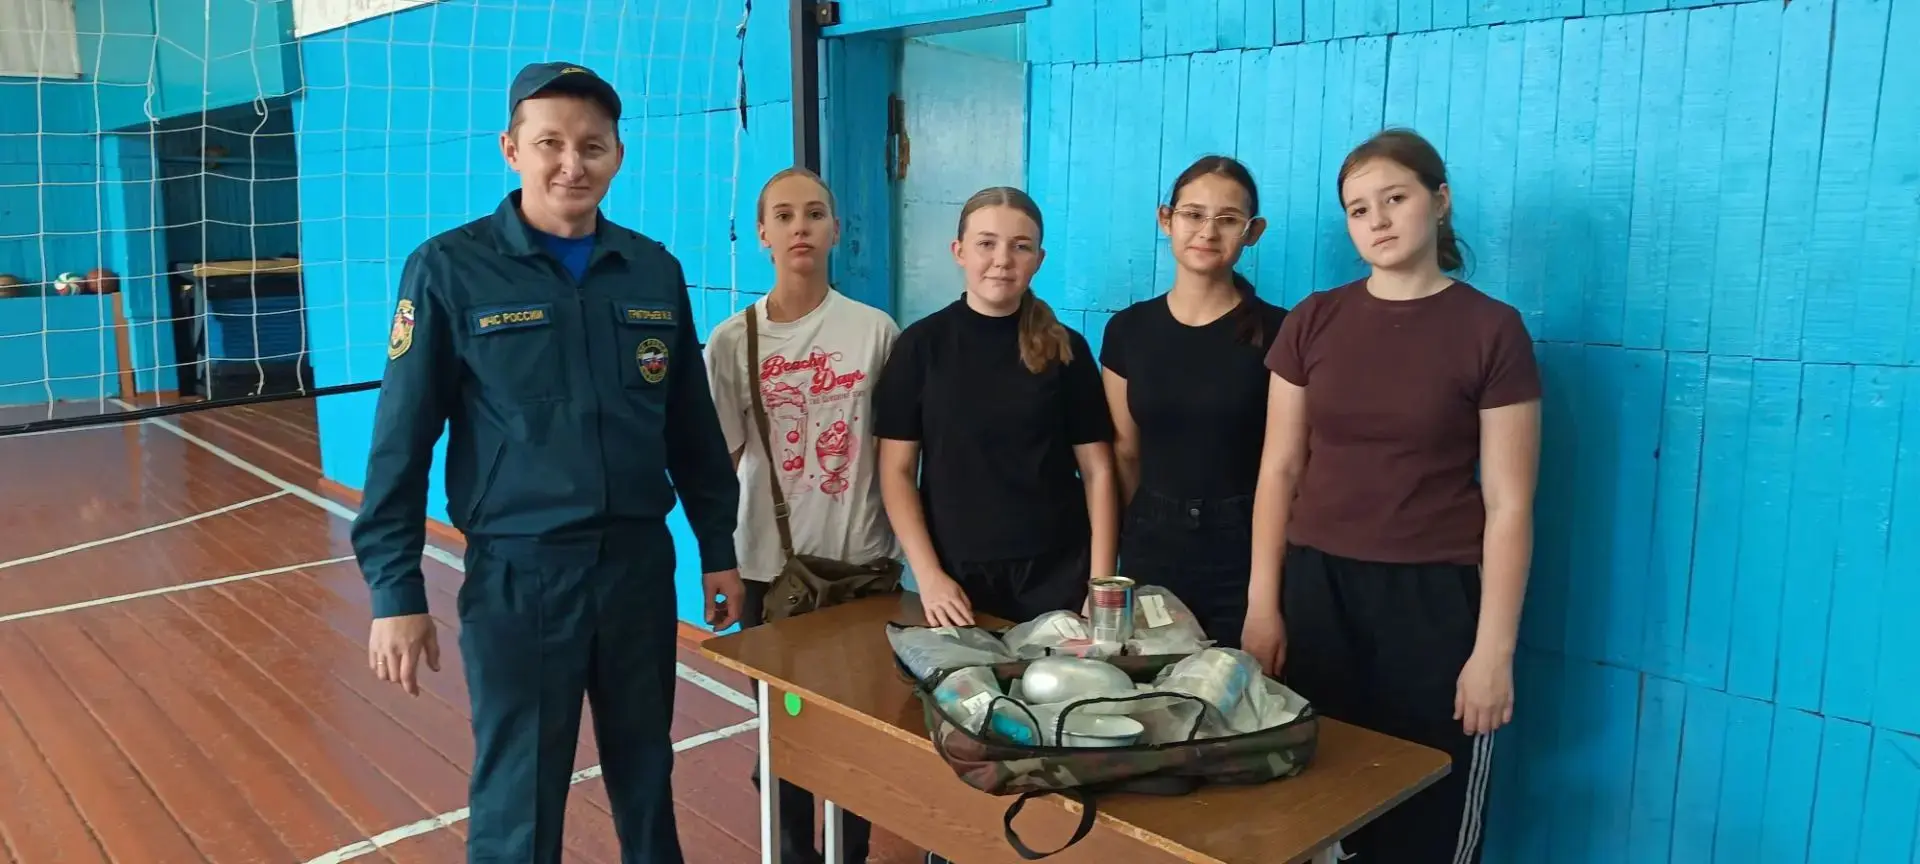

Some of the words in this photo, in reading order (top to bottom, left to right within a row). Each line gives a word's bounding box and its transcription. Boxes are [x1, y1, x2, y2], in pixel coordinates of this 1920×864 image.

[479, 314, 501, 328] МЧС
[502, 309, 544, 323] РОССИИ
[760, 352, 827, 380] Beachy
[809, 367, 865, 394] Days
